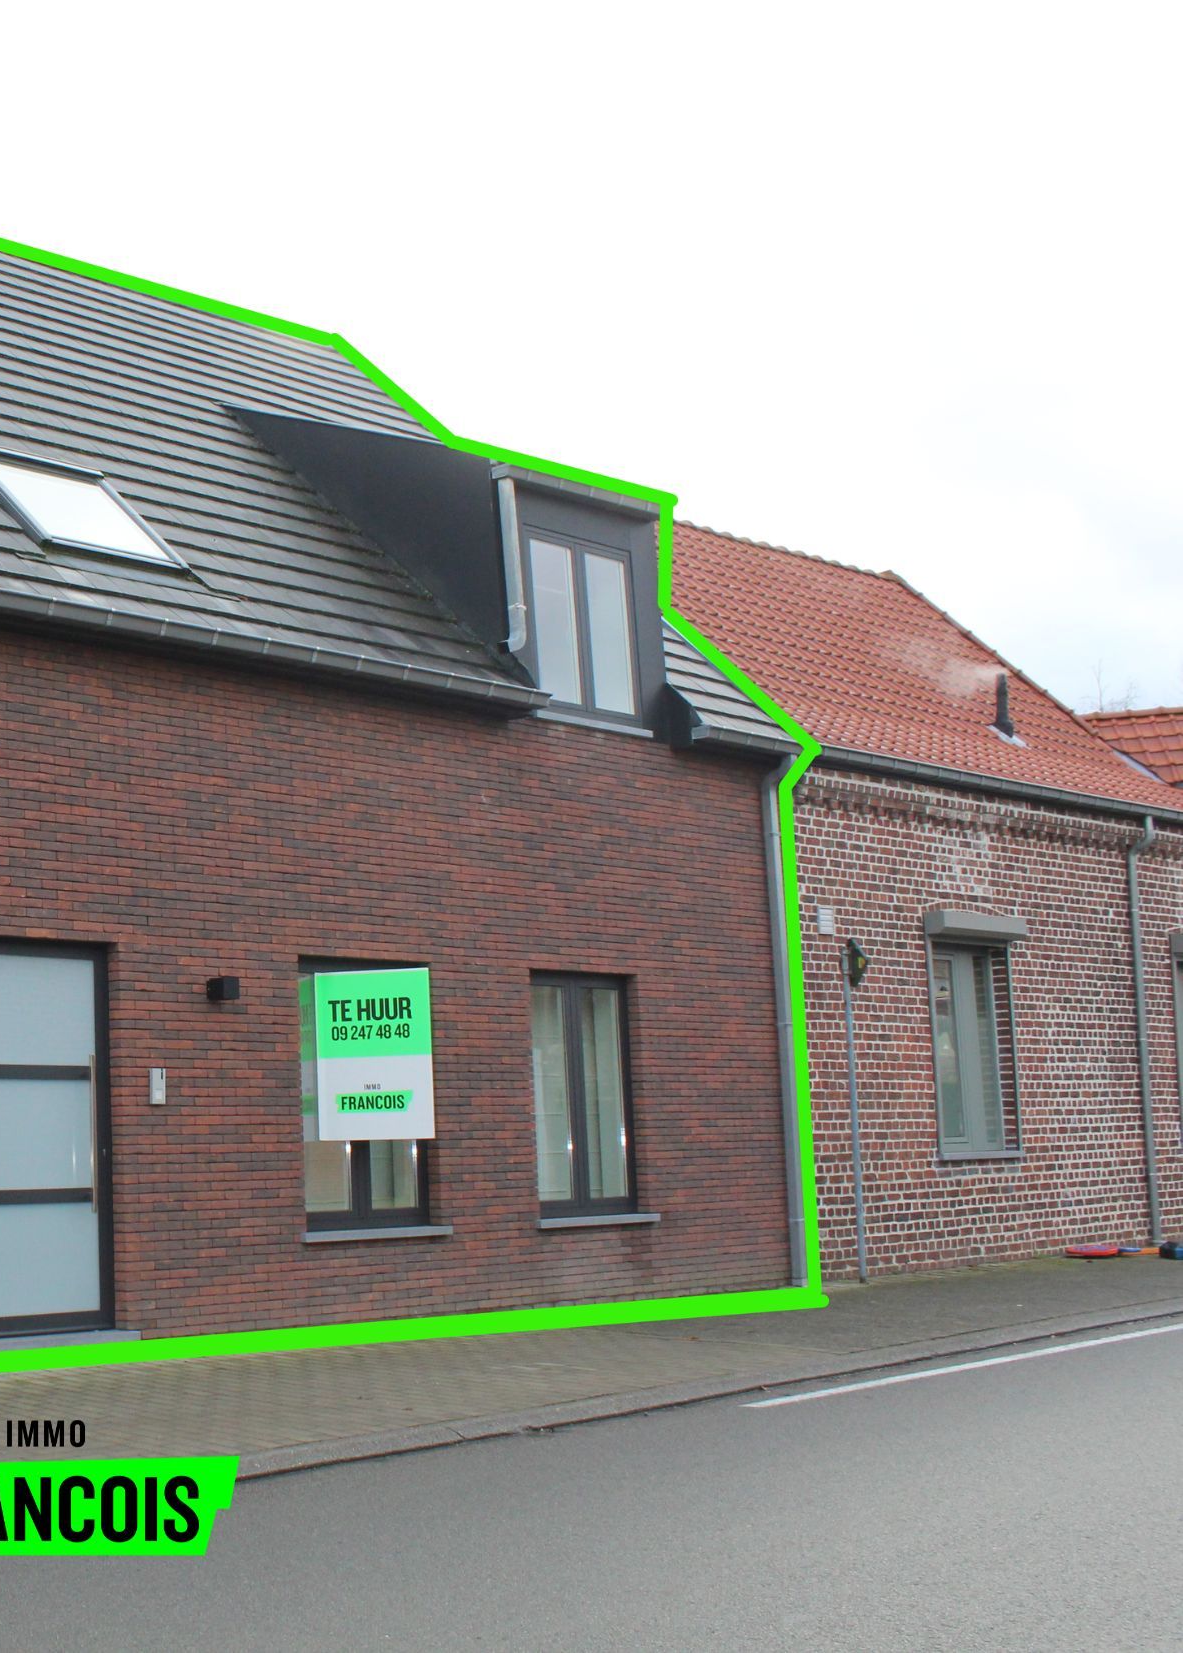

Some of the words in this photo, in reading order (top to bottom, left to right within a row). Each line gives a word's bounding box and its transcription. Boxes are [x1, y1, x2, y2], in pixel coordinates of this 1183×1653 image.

[327, 999, 352, 1022] TE
[357, 997, 412, 1021] HUUR
[331, 1026, 348, 1041] 09
[351, 1025, 373, 1040] 247
[376, 1024, 392, 1039] 48
[394, 1023, 410, 1039] 48
[341, 1094, 405, 1110] FRANCOIS
